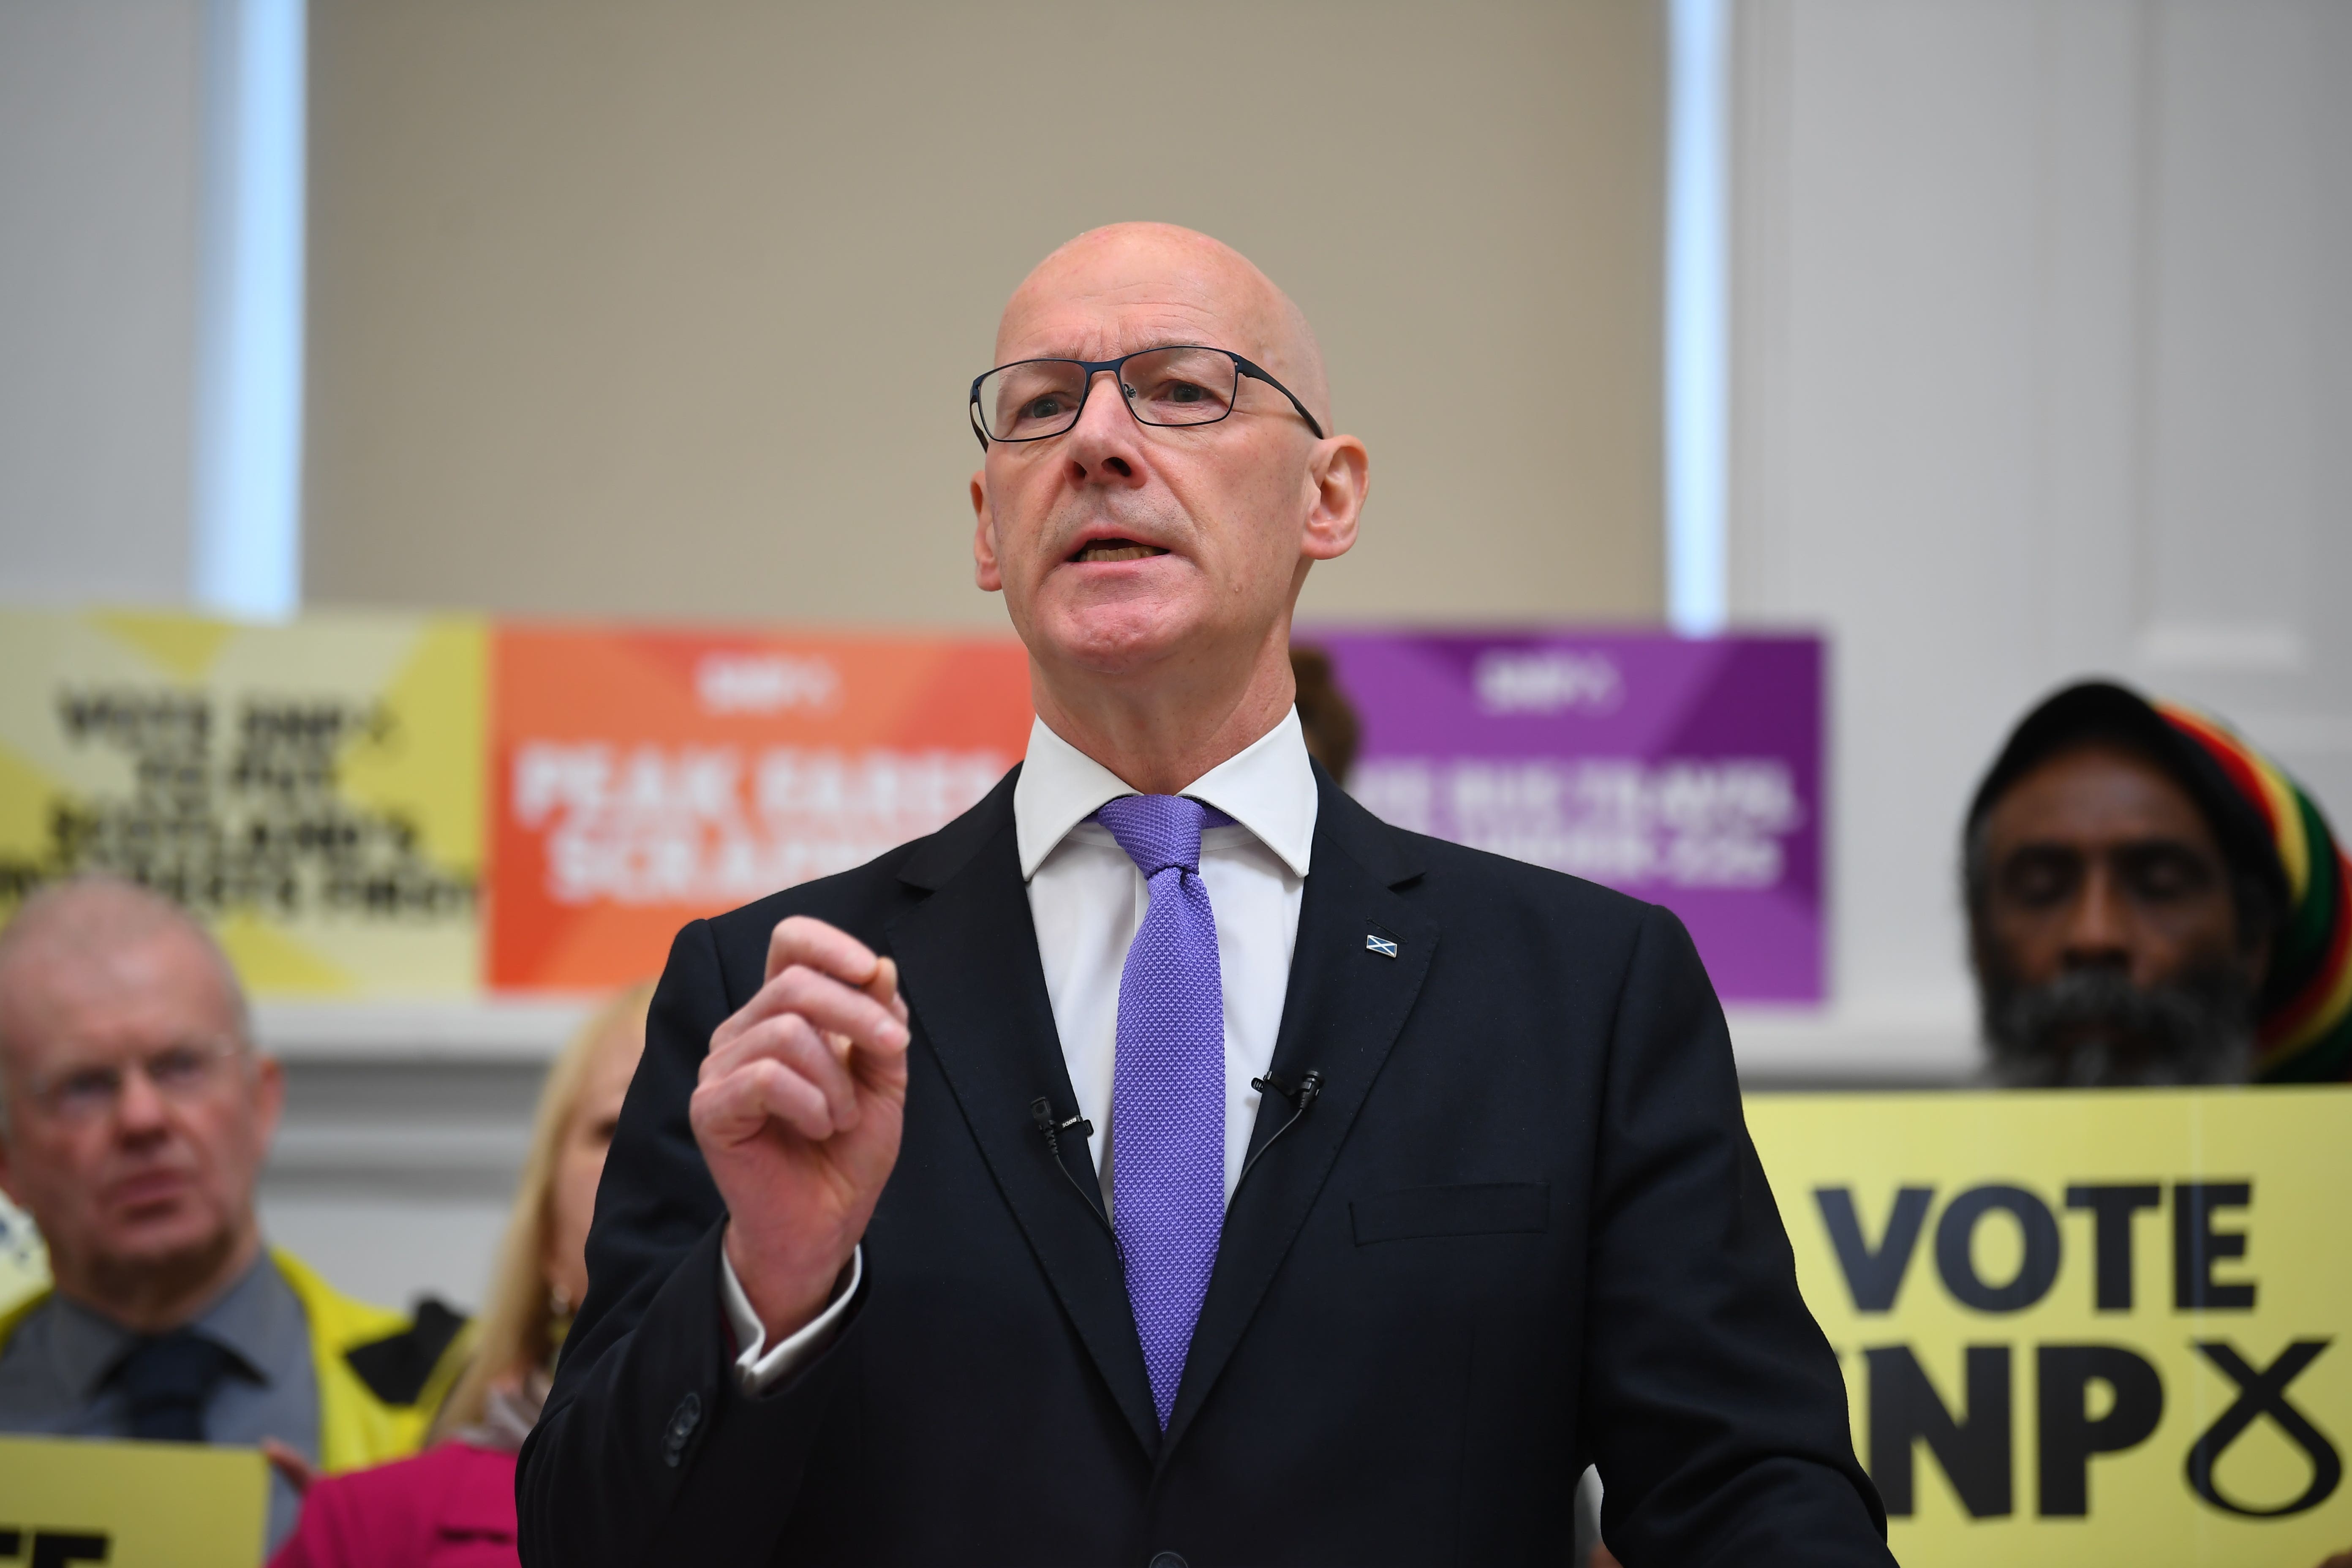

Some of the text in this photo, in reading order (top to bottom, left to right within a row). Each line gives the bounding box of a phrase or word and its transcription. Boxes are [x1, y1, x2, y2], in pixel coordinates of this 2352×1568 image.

[517, 747, 743, 827] PEAK
[1811, 1179, 2259, 1318] VOTE
[1832, 1342, 2167, 1523] NP
